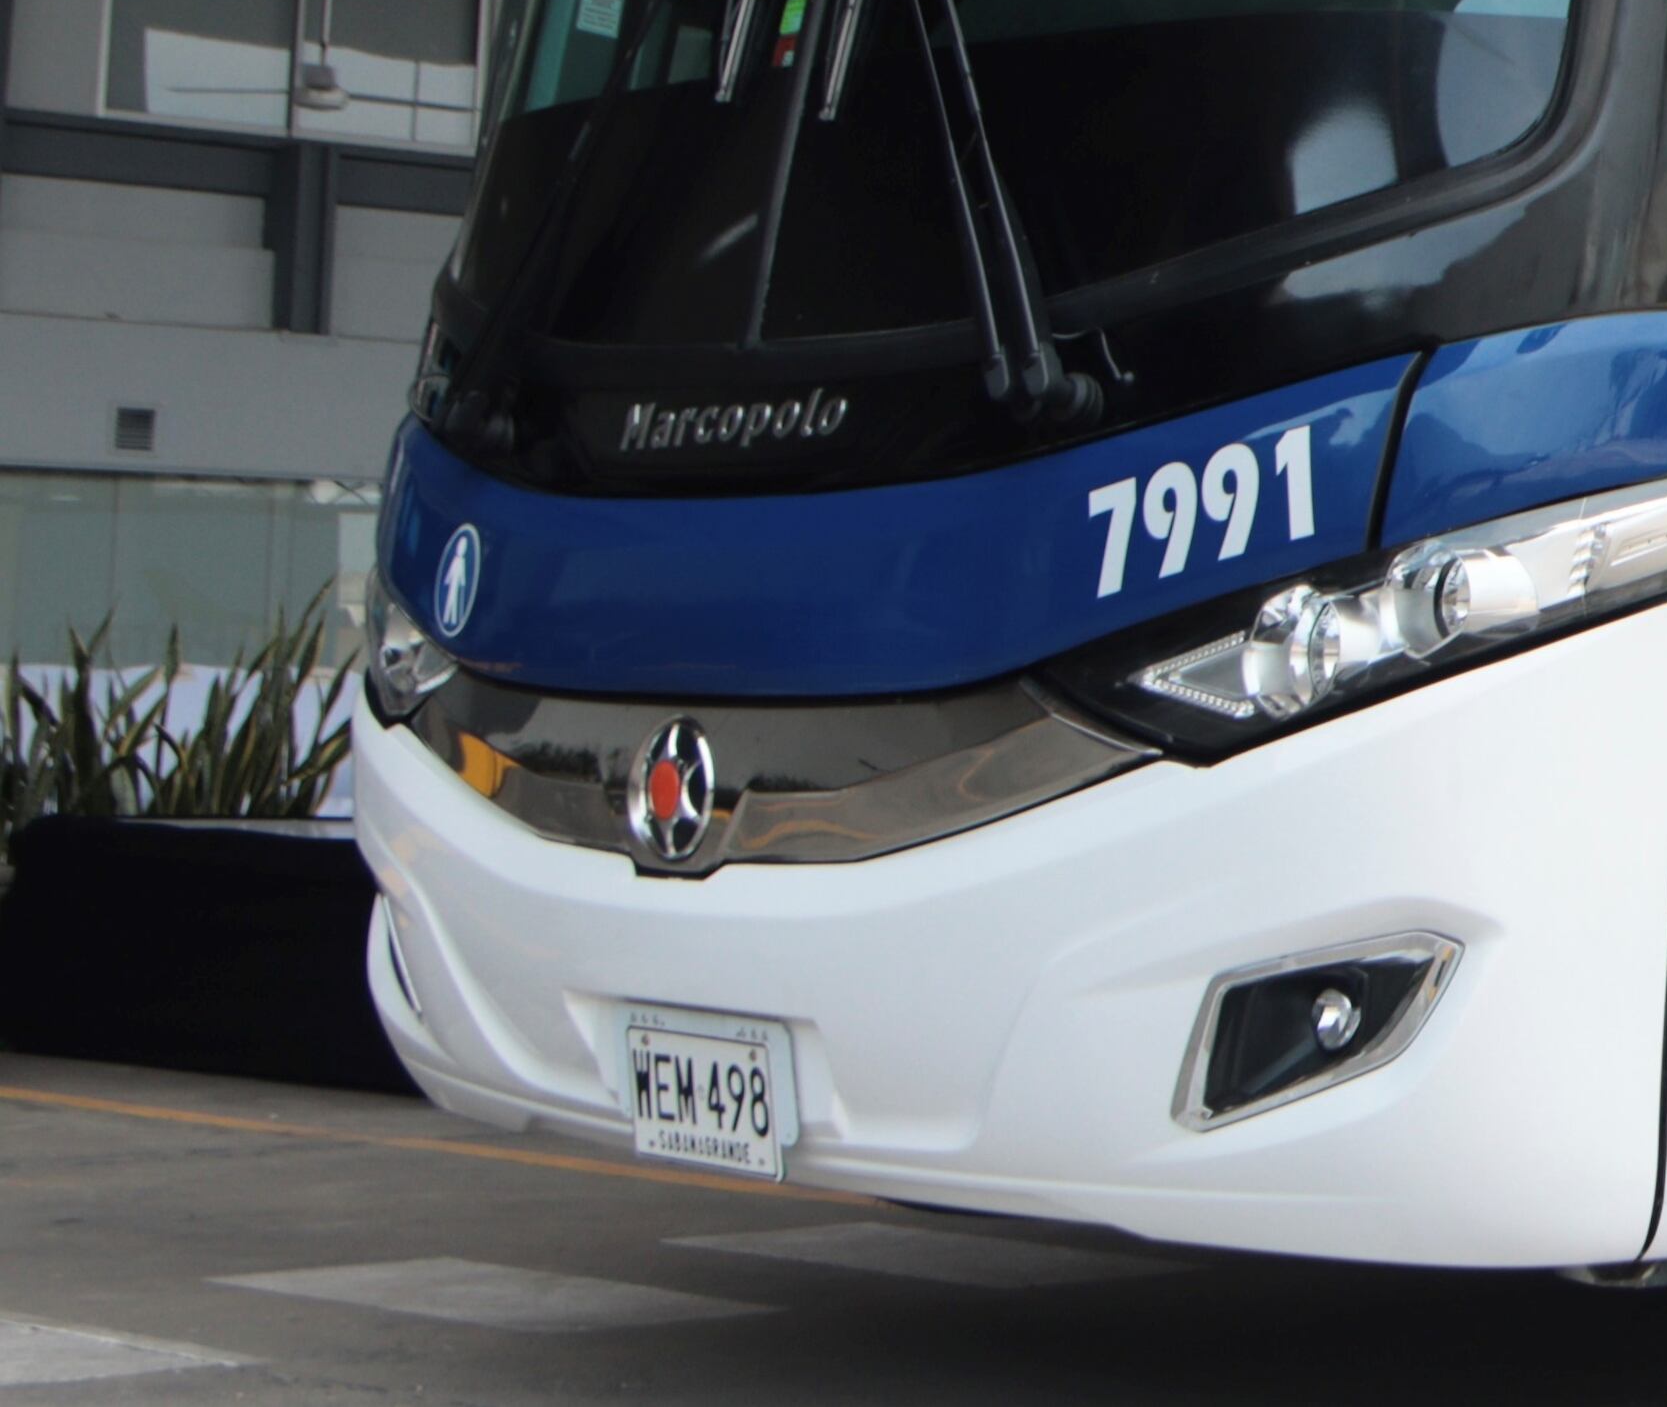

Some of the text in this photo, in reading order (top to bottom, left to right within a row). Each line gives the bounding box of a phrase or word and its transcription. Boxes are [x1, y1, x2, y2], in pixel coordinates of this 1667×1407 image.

[619, 388, 848, 451] Marcopolo
[1087, 425, 1316, 598] 7991
[633, 1049, 770, 1138] WEM 498
